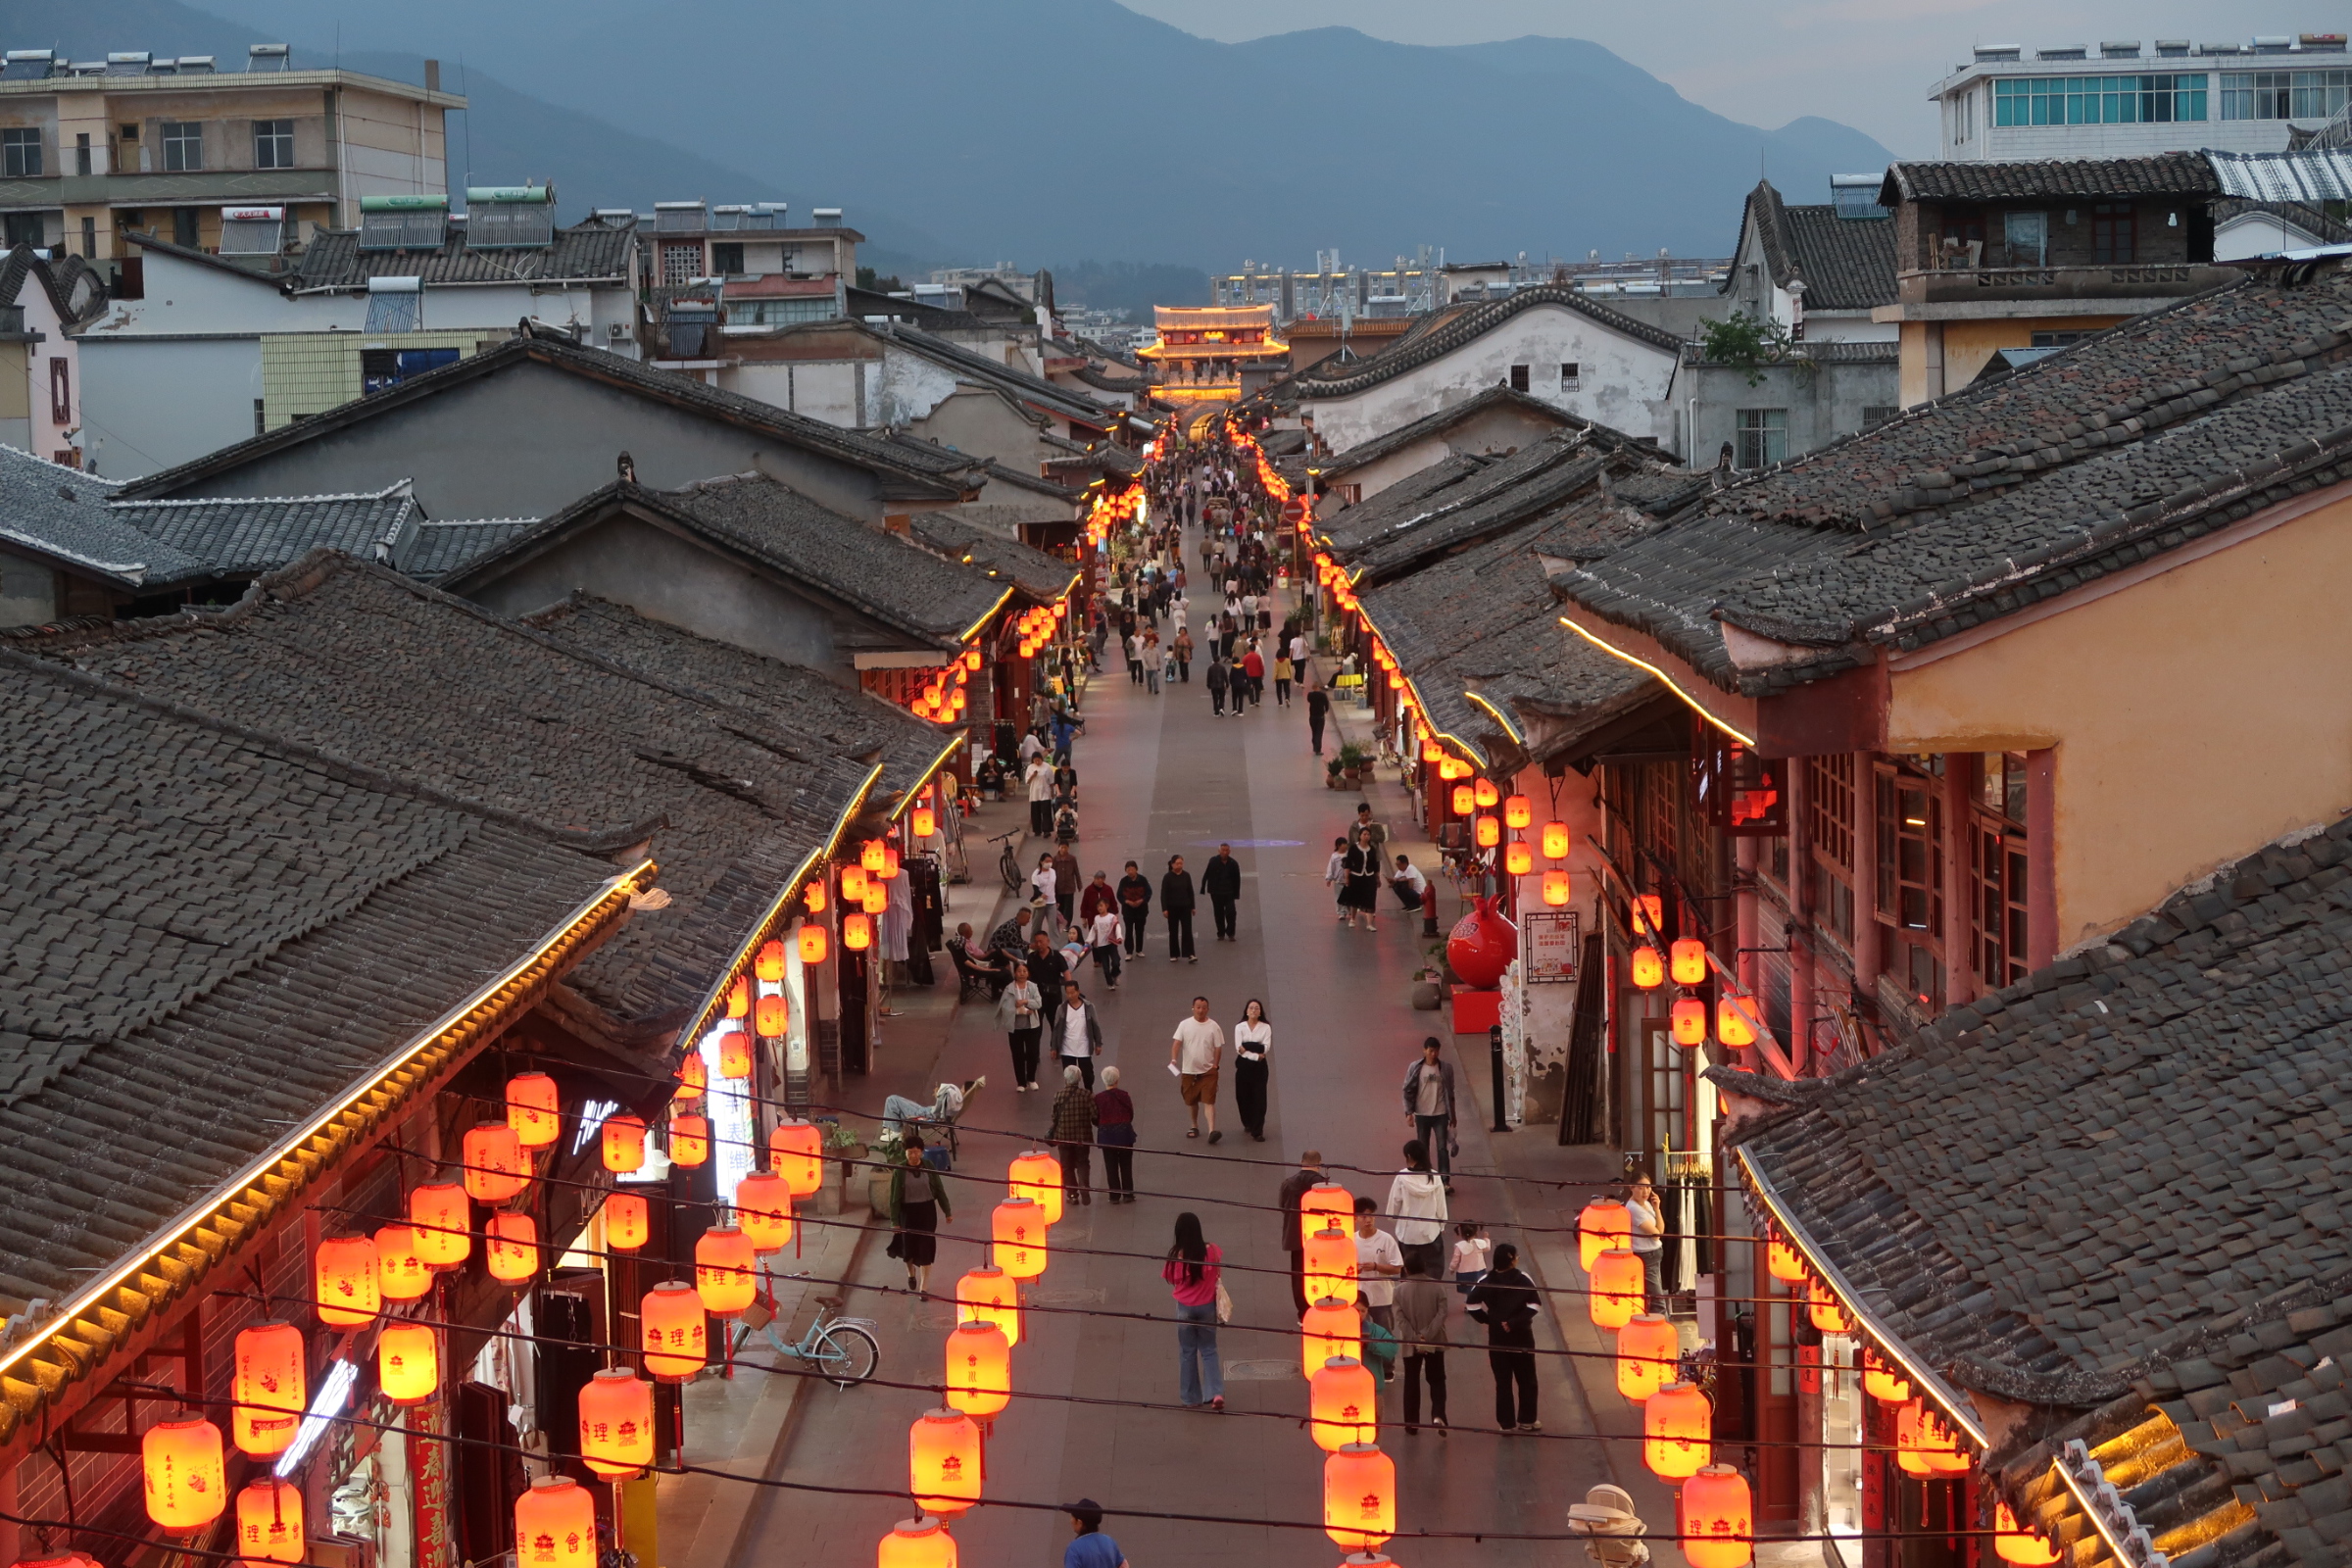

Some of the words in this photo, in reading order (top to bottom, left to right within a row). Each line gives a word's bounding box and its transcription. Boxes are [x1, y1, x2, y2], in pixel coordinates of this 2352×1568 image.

[670, 1328, 684, 1347] 理
[593, 1422, 609, 1443] 理
[246, 1524, 260, 1543] 理
[565, 1531, 580, 1554] 會
